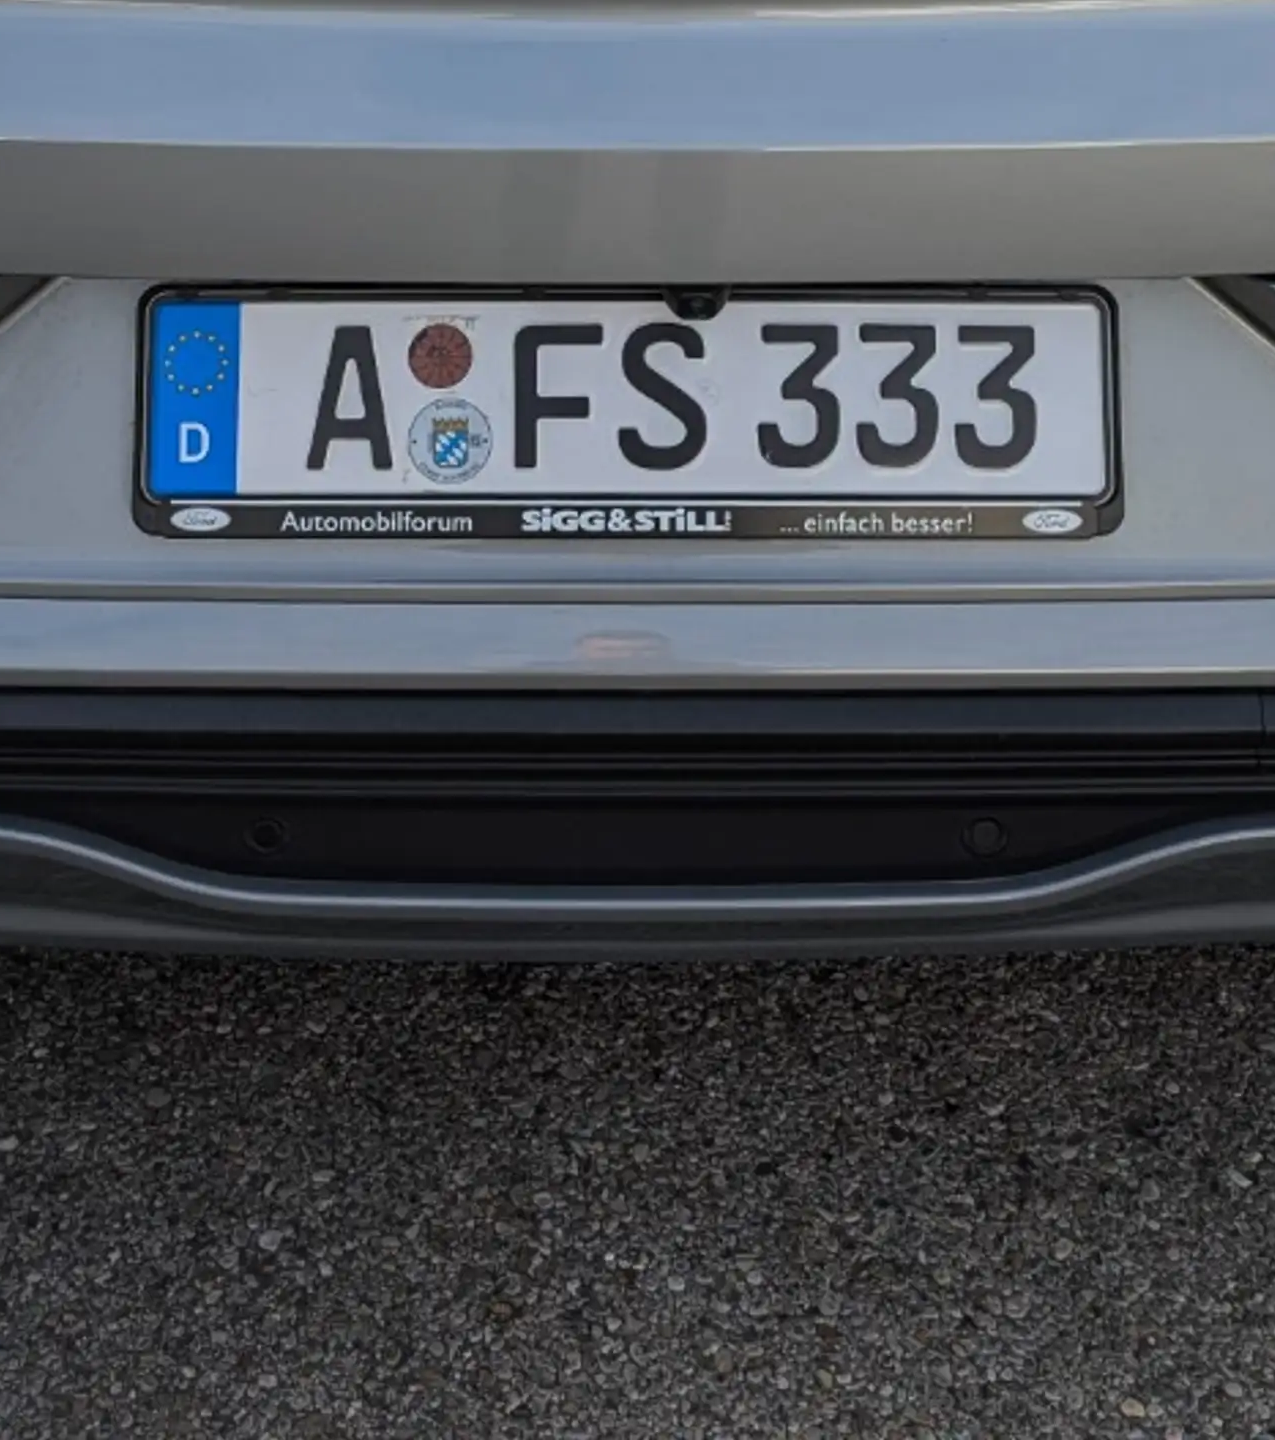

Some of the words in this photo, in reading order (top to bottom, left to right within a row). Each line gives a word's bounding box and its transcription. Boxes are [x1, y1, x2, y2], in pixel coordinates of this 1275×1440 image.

[306, 325, 394, 471] A
[513, 321, 709, 472] FS
[757, 323, 1038, 469] 333
[178, 421, 211, 463] D
[280, 510, 474, 533] Automobilforum
[803, 511, 884, 534] einfach
[890, 511, 974, 534] besser!
